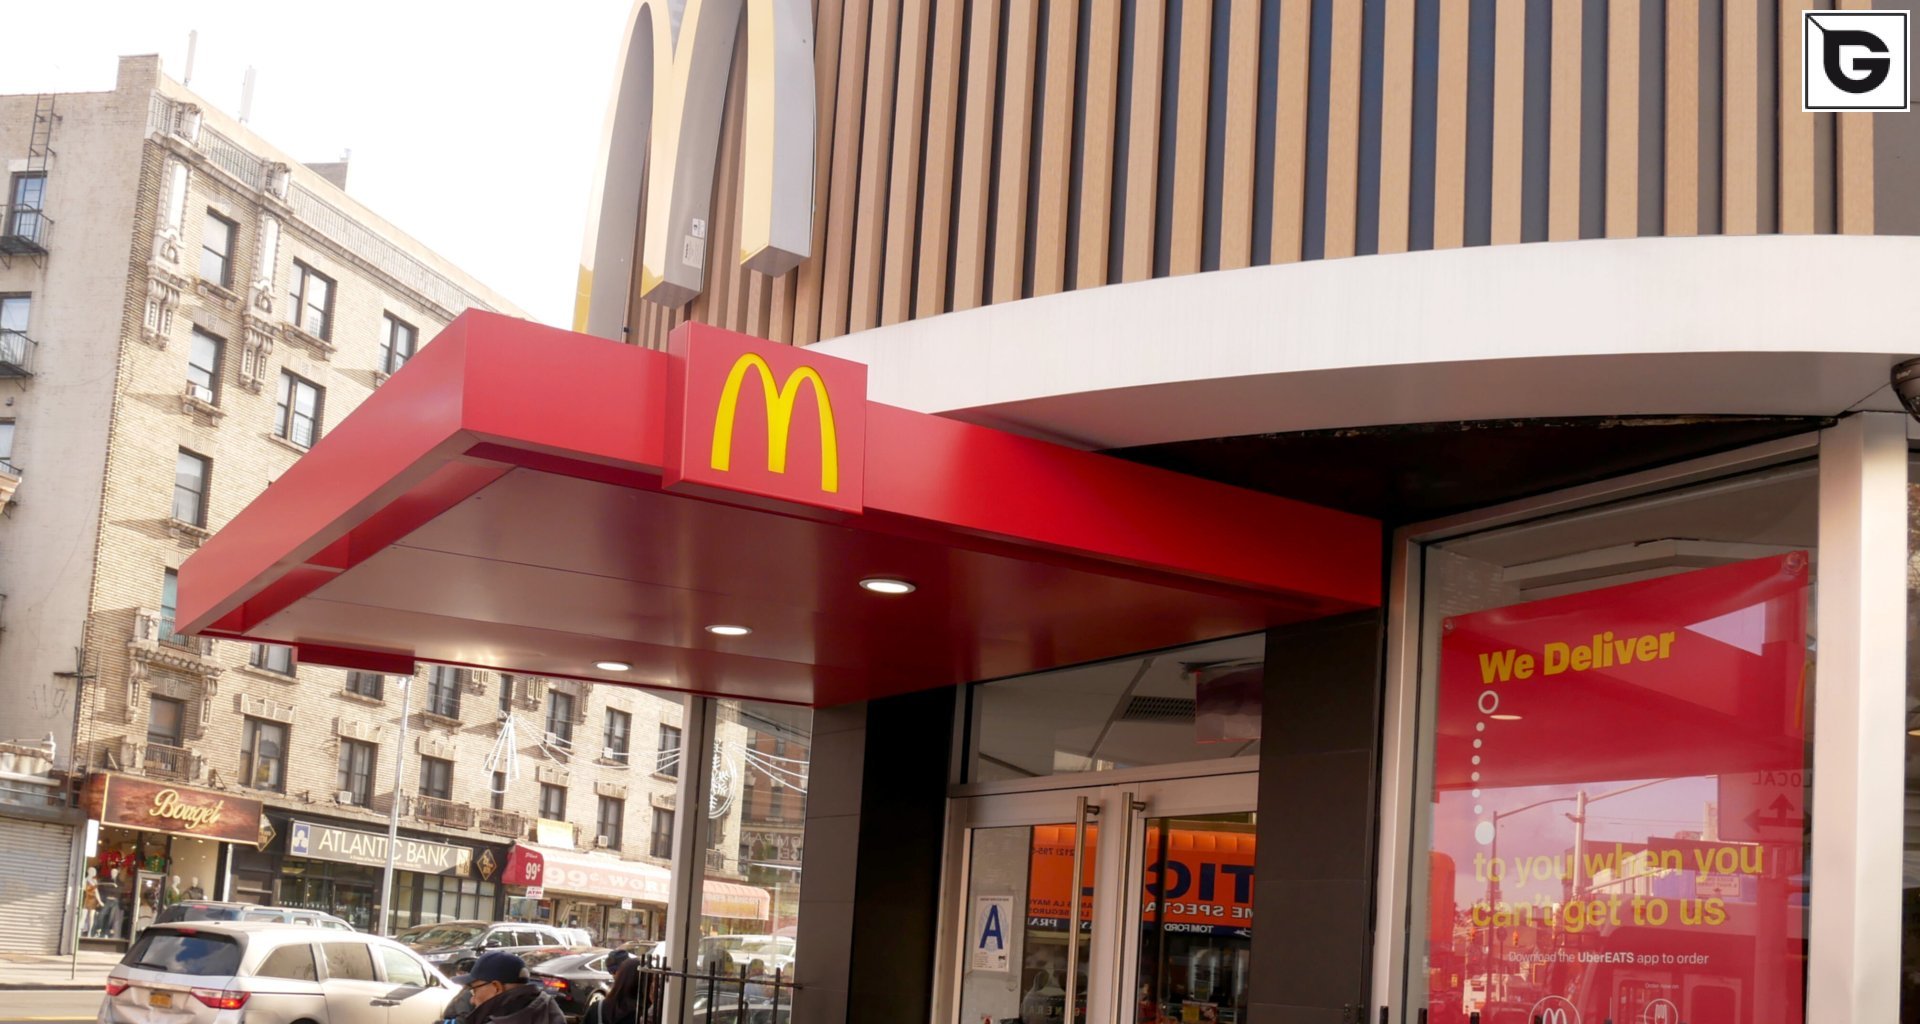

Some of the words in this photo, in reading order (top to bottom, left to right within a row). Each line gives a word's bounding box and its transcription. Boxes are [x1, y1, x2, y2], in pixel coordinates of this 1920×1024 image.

[1479, 649, 1534, 684] We
[1544, 631, 1676, 676] Deliver
[407, 841, 451, 867] BANK
[1474, 852, 1506, 881] to
[1516, 857, 1574, 889] you
[1585, 843, 1683, 877] when
[1694, 846, 1764, 884] you
[979, 905, 1003, 949] A
[1472, 895, 1556, 927] can't
[1564, 897, 1621, 933] get
[1632, 897, 1669, 925] to
[1680, 897, 1727, 925] us
[1509, 952, 1556, 962] Download
[1558, 952, 1576, 962] the
[1578, 952, 1634, 963] UberEATS
[1637, 954, 1659, 965] app
[1662, 953, 1674, 964] to
[1677, 952, 1709, 964] order
